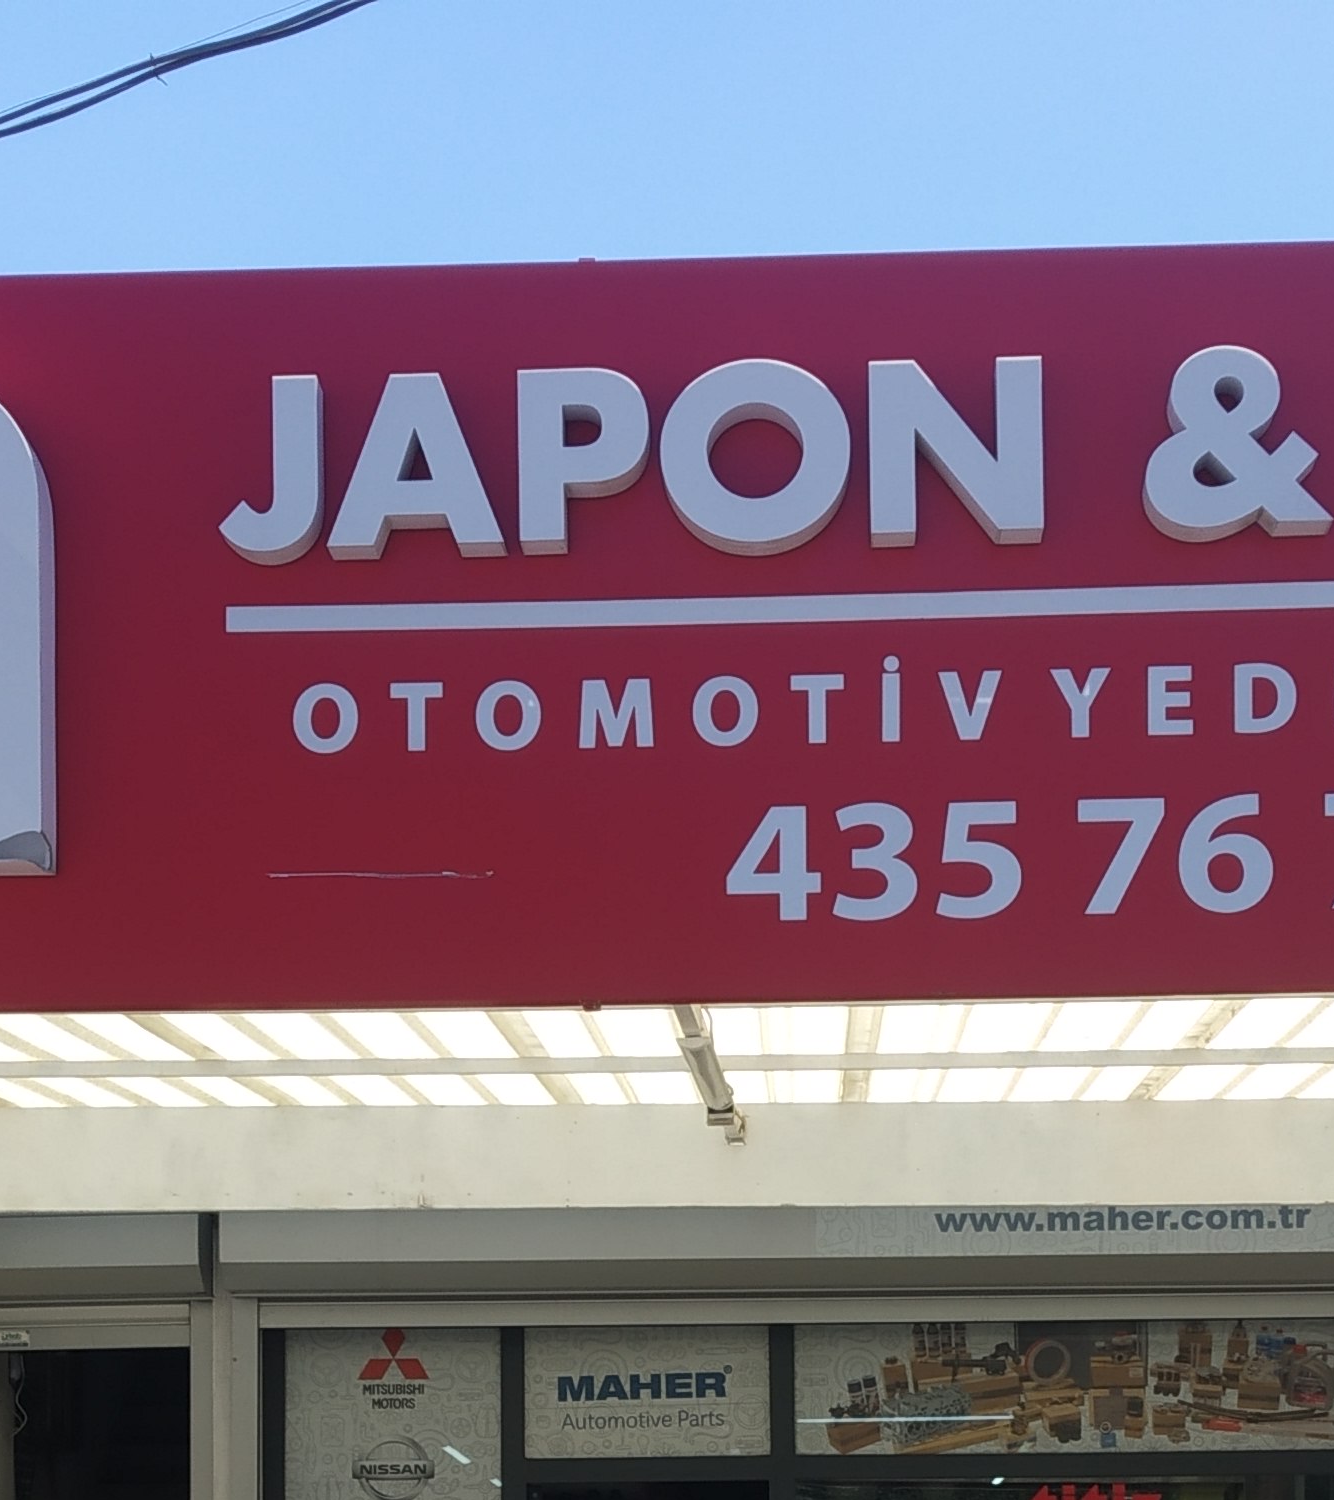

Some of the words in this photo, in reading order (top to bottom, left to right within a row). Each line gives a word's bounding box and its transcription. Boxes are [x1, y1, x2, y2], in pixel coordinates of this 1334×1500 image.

[219, 356, 1045, 565] JAPON
[1143, 345, 1333, 542] &
[293, 655, 1002, 753] OTOMOTİV
[726, 801, 1023, 921] 435
[1077, 793, 1274, 914] 76
[935, 1205, 1311, 1234] www.maher.com.tr
[362, 1384, 424, 1395] MITSUBISHI
[558, 1371, 727, 1402] MAHER
[372, 1399, 415, 1409] MOTORS
[562, 1411, 672, 1430] Automotive
[678, 1409, 725, 1428] Parts
[359, 1464, 427, 1475] NISSAN
